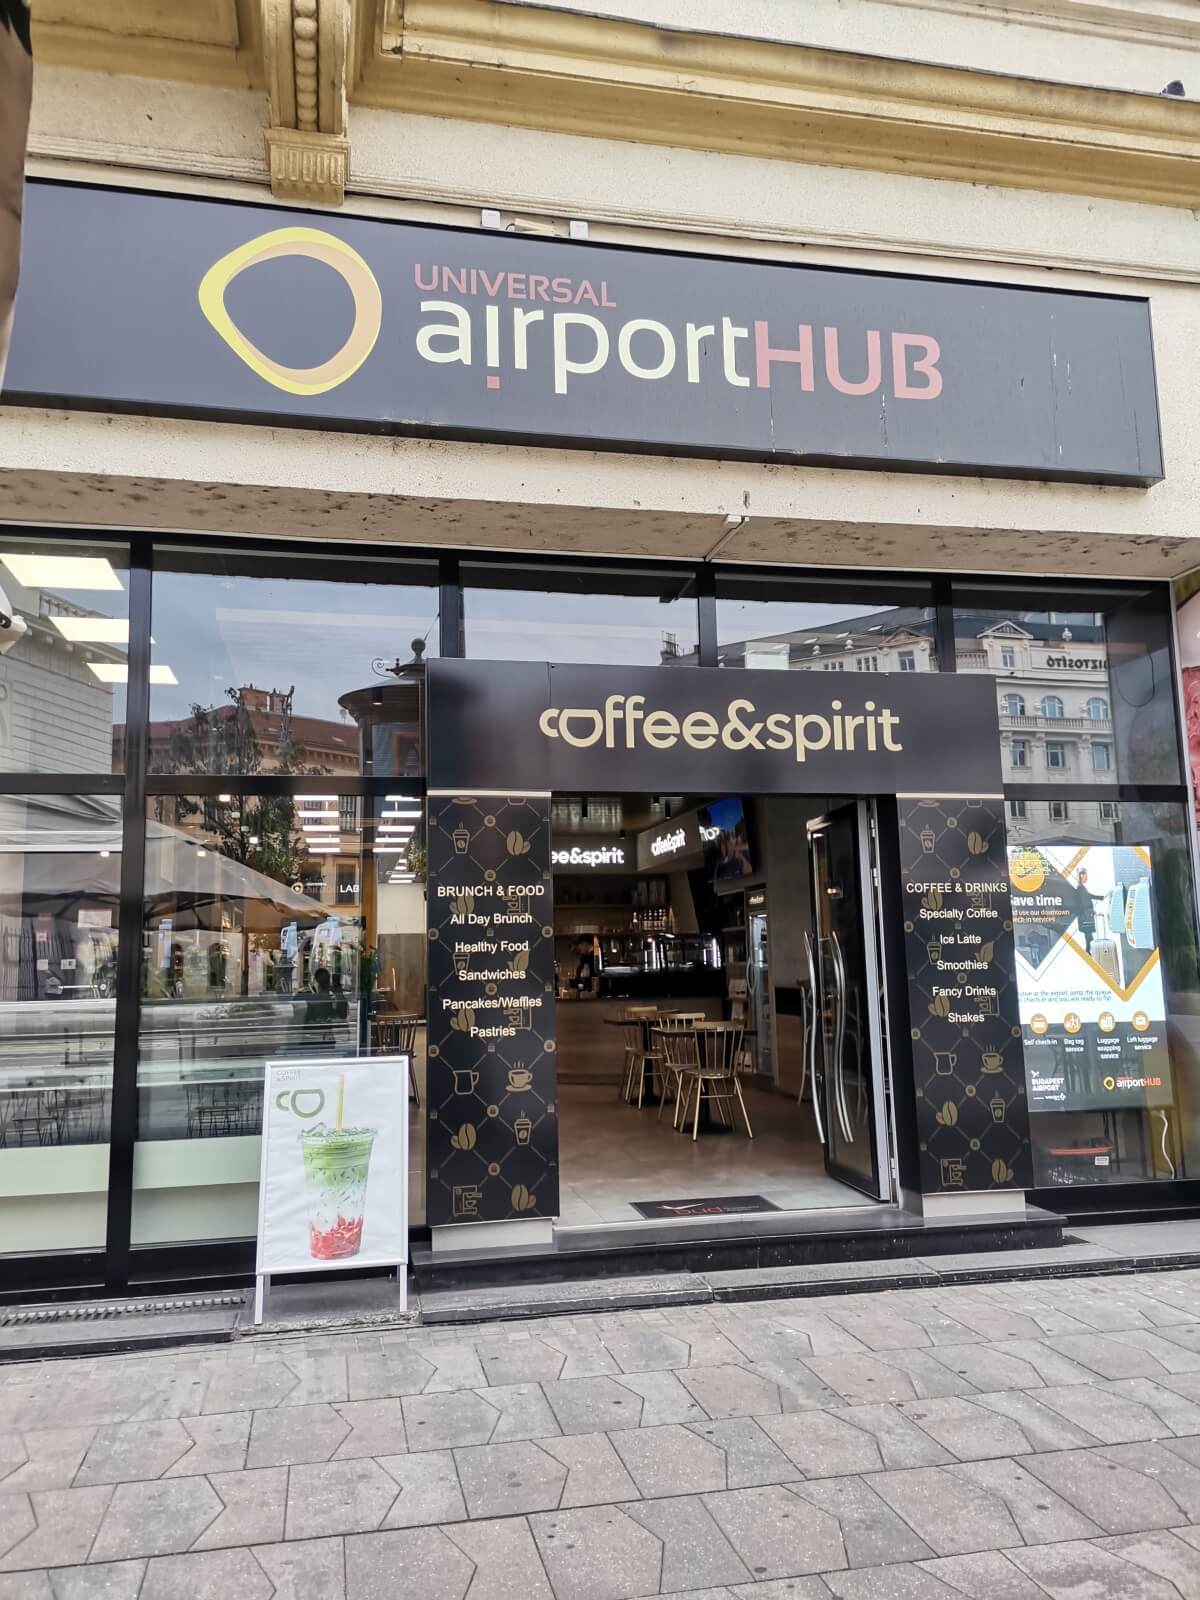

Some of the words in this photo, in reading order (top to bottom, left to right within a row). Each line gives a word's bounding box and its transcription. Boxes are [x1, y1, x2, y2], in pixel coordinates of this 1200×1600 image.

[414, 263, 616, 308] UNIVERSAL
[416, 300, 943, 400] airportHUB
[539, 695, 903, 762] coffee&spirit
[437, 886, 493, 897] BRUNCH
[496, 886, 505, 896] &
[508, 885, 545, 896] FOOD
[906, 883, 953, 893] COFFEE
[955, 883, 962, 893] &
[965, 883, 1008, 893] DRINKS
[1036, 894, 1062, 906] time
[450, 914, 465, 925] All
[468, 914, 490, 926] Day
[494, 913, 533, 924] Brunch
[919, 908, 963, 920] Specialty
[966, 908, 998, 918] Coffee
[940, 934, 954, 944] Ice
[957, 934, 982, 944] Latte
[455, 942, 497, 954] Healthy
[501, 941, 529, 951] Food
[937, 960, 988, 970] Smoothies
[459, 969, 526, 981] Sandwiches
[932, 986, 962, 998] Fancy
[965, 986, 996, 996] Drinks
[442, 997, 542, 1010] Pancakes/Waffles
[948, 1012, 984, 1023] Shakes
[470, 1026, 516, 1038] Pastries
